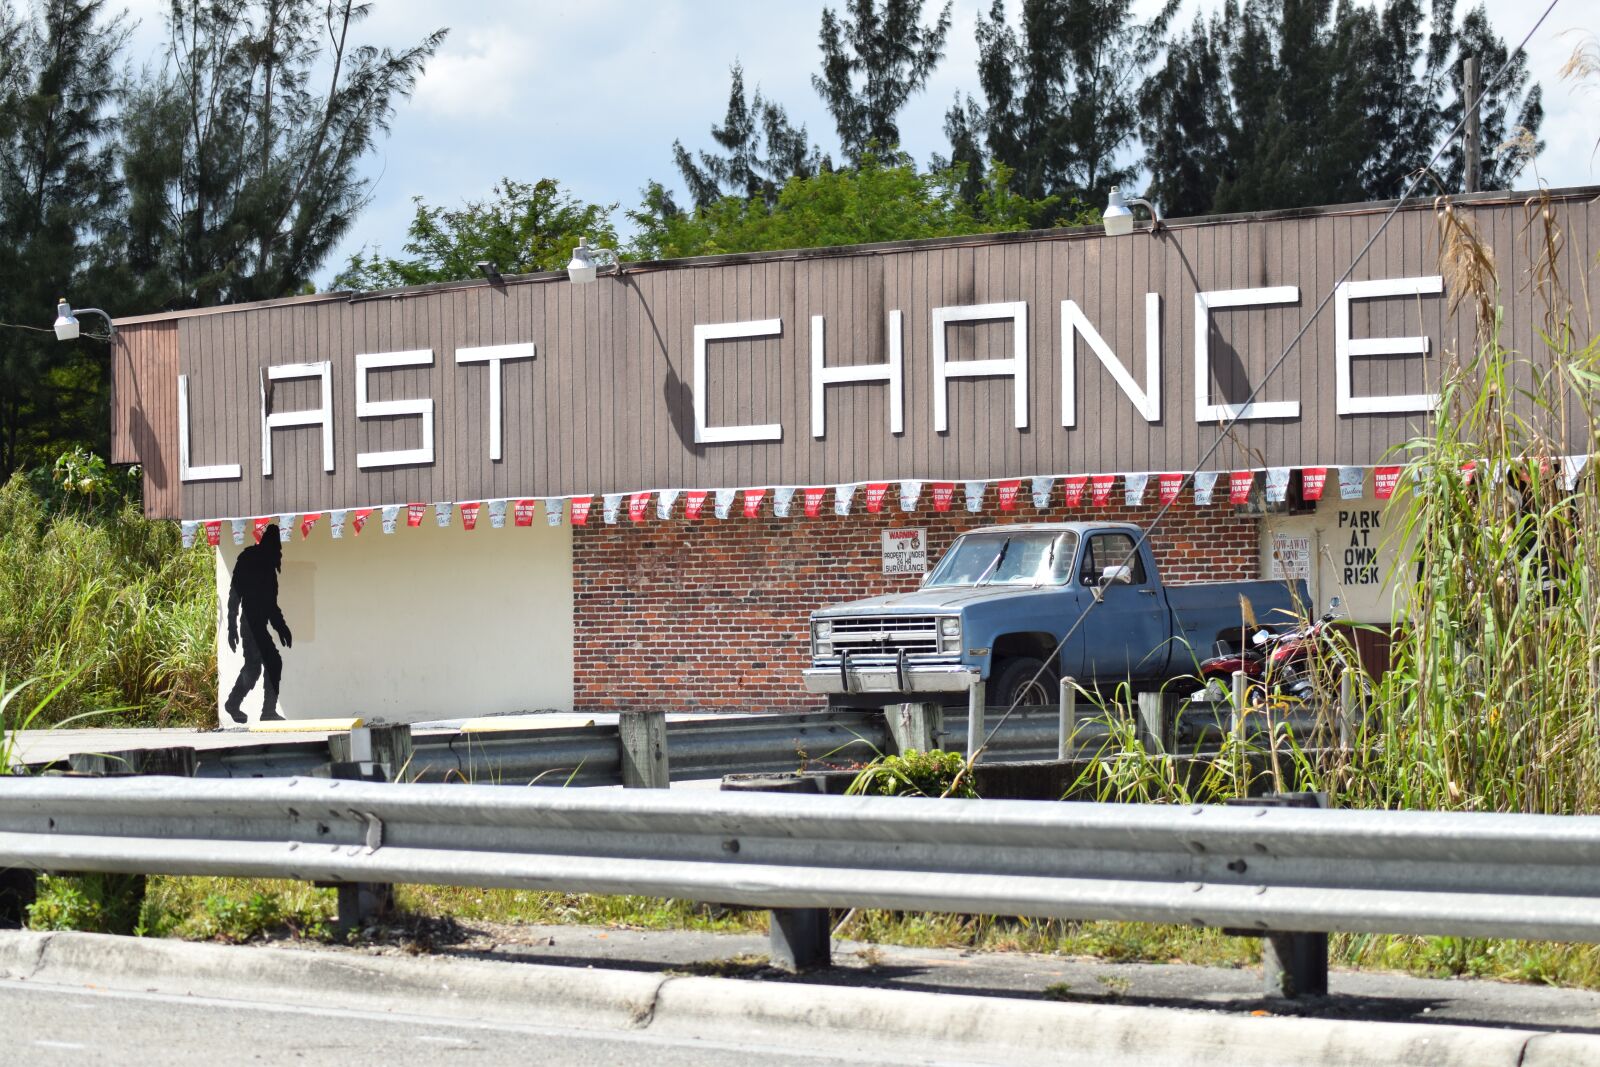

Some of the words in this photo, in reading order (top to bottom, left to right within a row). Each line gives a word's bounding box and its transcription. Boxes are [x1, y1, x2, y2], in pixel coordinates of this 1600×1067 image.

[179, 343, 535, 482] LAST
[693, 275, 1444, 445] CHANCE
[1338, 510, 1380, 528] PARK
[889, 531, 919, 540] WARNING
[1350, 529, 1370, 547] AT
[884, 551, 907, 559] PROPERTY
[907, 550, 925, 559] UNDER
[1344, 547, 1377, 566] OWN
[1344, 566, 1379, 585] RISK
